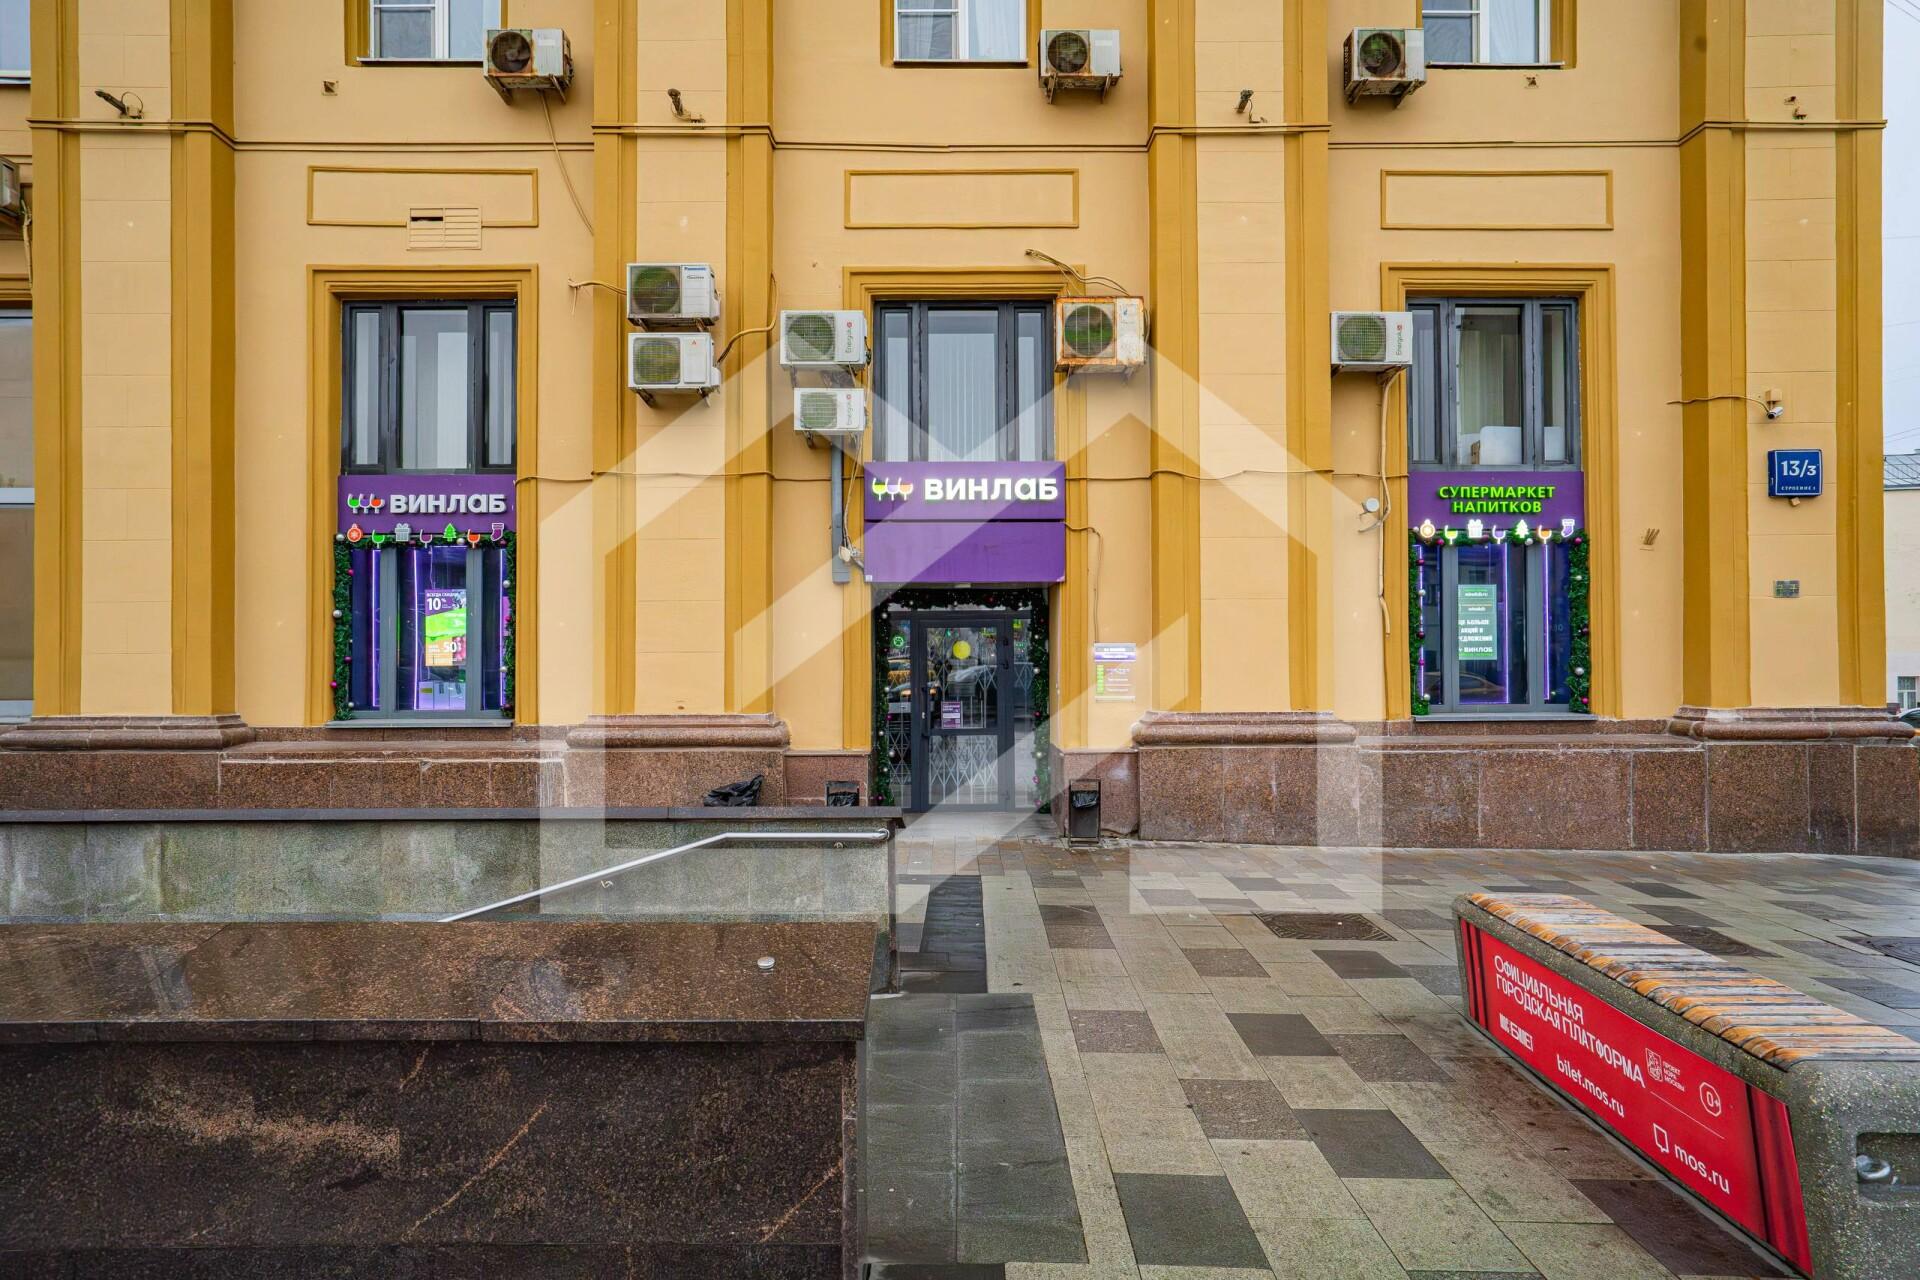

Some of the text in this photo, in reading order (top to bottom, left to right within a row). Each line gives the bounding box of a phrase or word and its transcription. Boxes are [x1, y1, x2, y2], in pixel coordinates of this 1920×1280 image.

[1780, 459, 1817, 478] 13/3
[1439, 486, 1555, 499] СУПЕРМАРКЕТ
[1453, 501, 1542, 513] НАПИТКОВ
[1494, 955, 1584, 1025] ОФИЦИАЛЬНАЯ
[1496, 973, 1646, 1089] ГОРОДСКАЯ ПЛАТФОРМА
[1556, 1053, 1625, 1119] bilet.mos.ru
[1705, 1091, 1720, 1108] 0+
[1674, 1143, 1731, 1195] mos.ru
